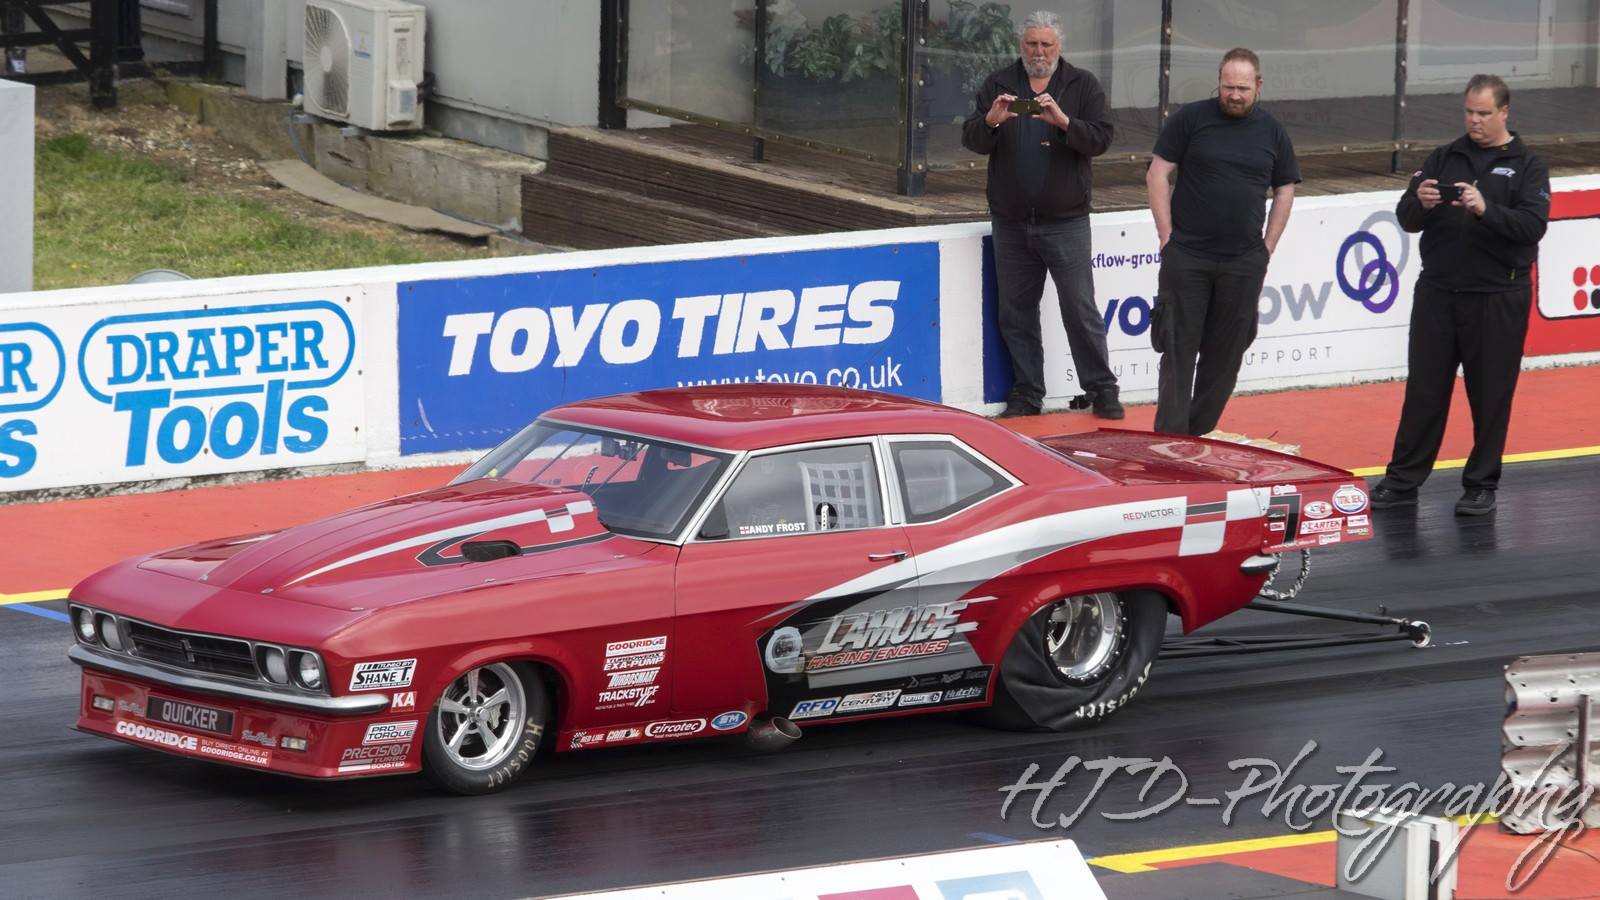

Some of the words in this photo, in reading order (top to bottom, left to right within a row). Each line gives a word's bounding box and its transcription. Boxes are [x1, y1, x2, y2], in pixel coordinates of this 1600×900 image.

[442, 298, 662, 376] TOYO
[670, 280, 901, 358] TIRES
[106, 320, 329, 385] DRAPER
[1244, 346, 1332, 366] UPPORT
[113, 379, 329, 467] Tools
[749, 524, 774, 534] ANDY
[776, 522, 805, 533] FROST
[608, 638, 665, 651] GOODRIDGE
[807, 649, 873, 670] RACING
[875, 640, 950, 661] ENGINES
[603, 657, 664, 671] EXA-PUMP
[354, 669, 397, 685] SHANE
[391, 692, 415, 707] KA
[796, 700, 836, 712] RFD
[162, 702, 218, 731] QUICKER
[115, 720, 198, 751] GOODRIDGE
[368, 730, 414, 740] TORQUE
[371, 725, 396, 733] PRO
[653, 720, 699, 735] zircotec
[215, 742, 237, 751] DIRECT
[341, 743, 411, 760] PRECISION
[200, 746, 268, 765] GOODRIDGE.CO.UK
